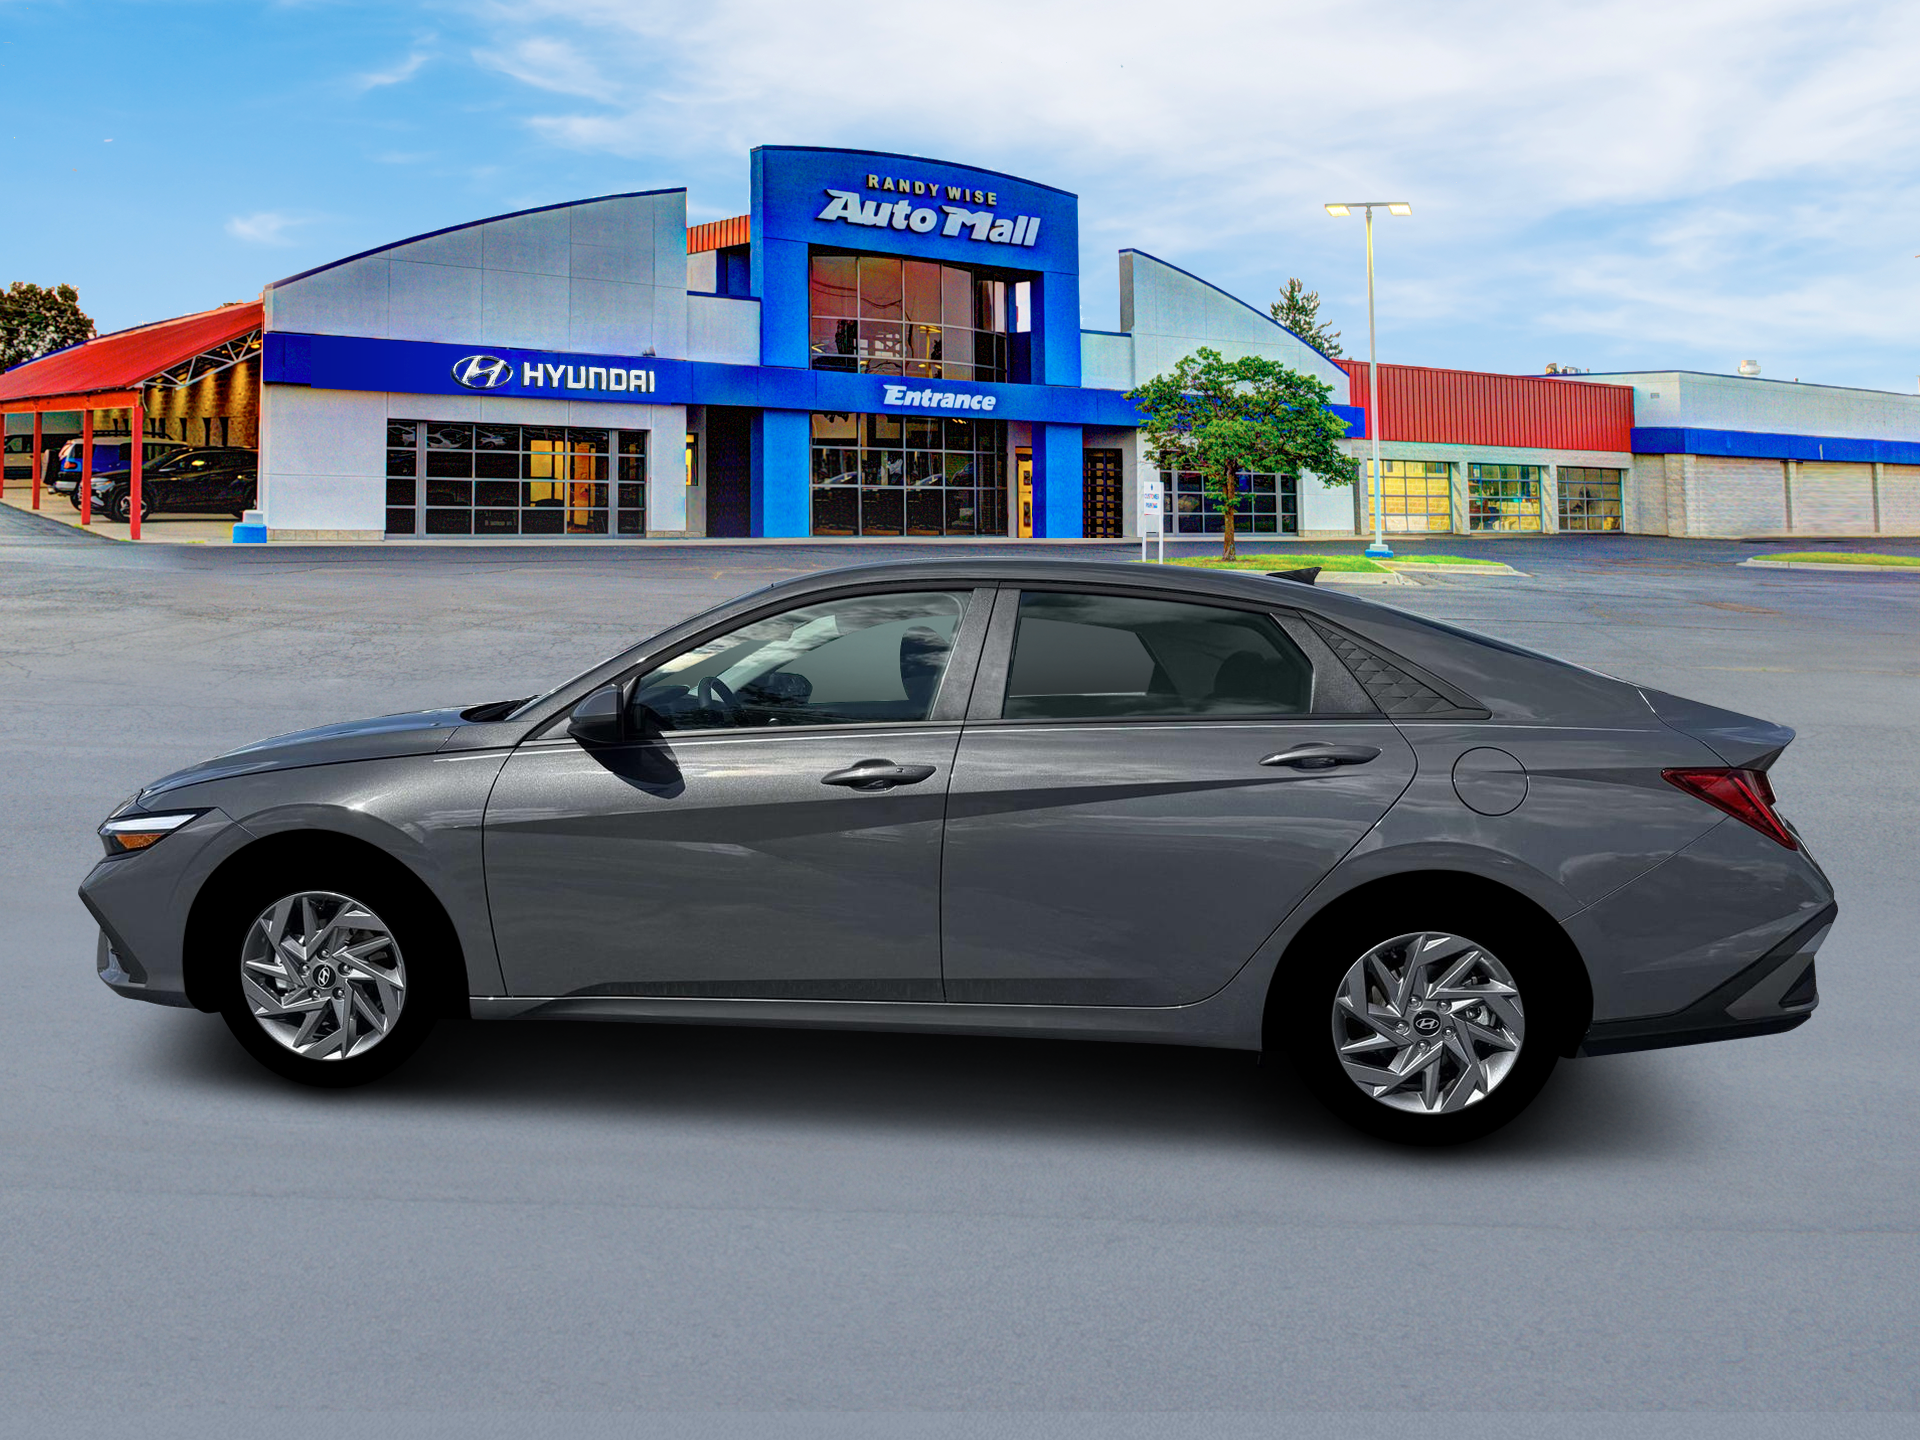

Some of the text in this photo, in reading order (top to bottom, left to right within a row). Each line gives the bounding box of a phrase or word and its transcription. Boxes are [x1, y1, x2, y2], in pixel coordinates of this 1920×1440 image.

[866, 173, 998, 206] RANDY WISE
[816, 188, 1041, 247] Auto Mall
[521, 361, 656, 393] HYUNDAI
[882, 384, 997, 411] Entrance
